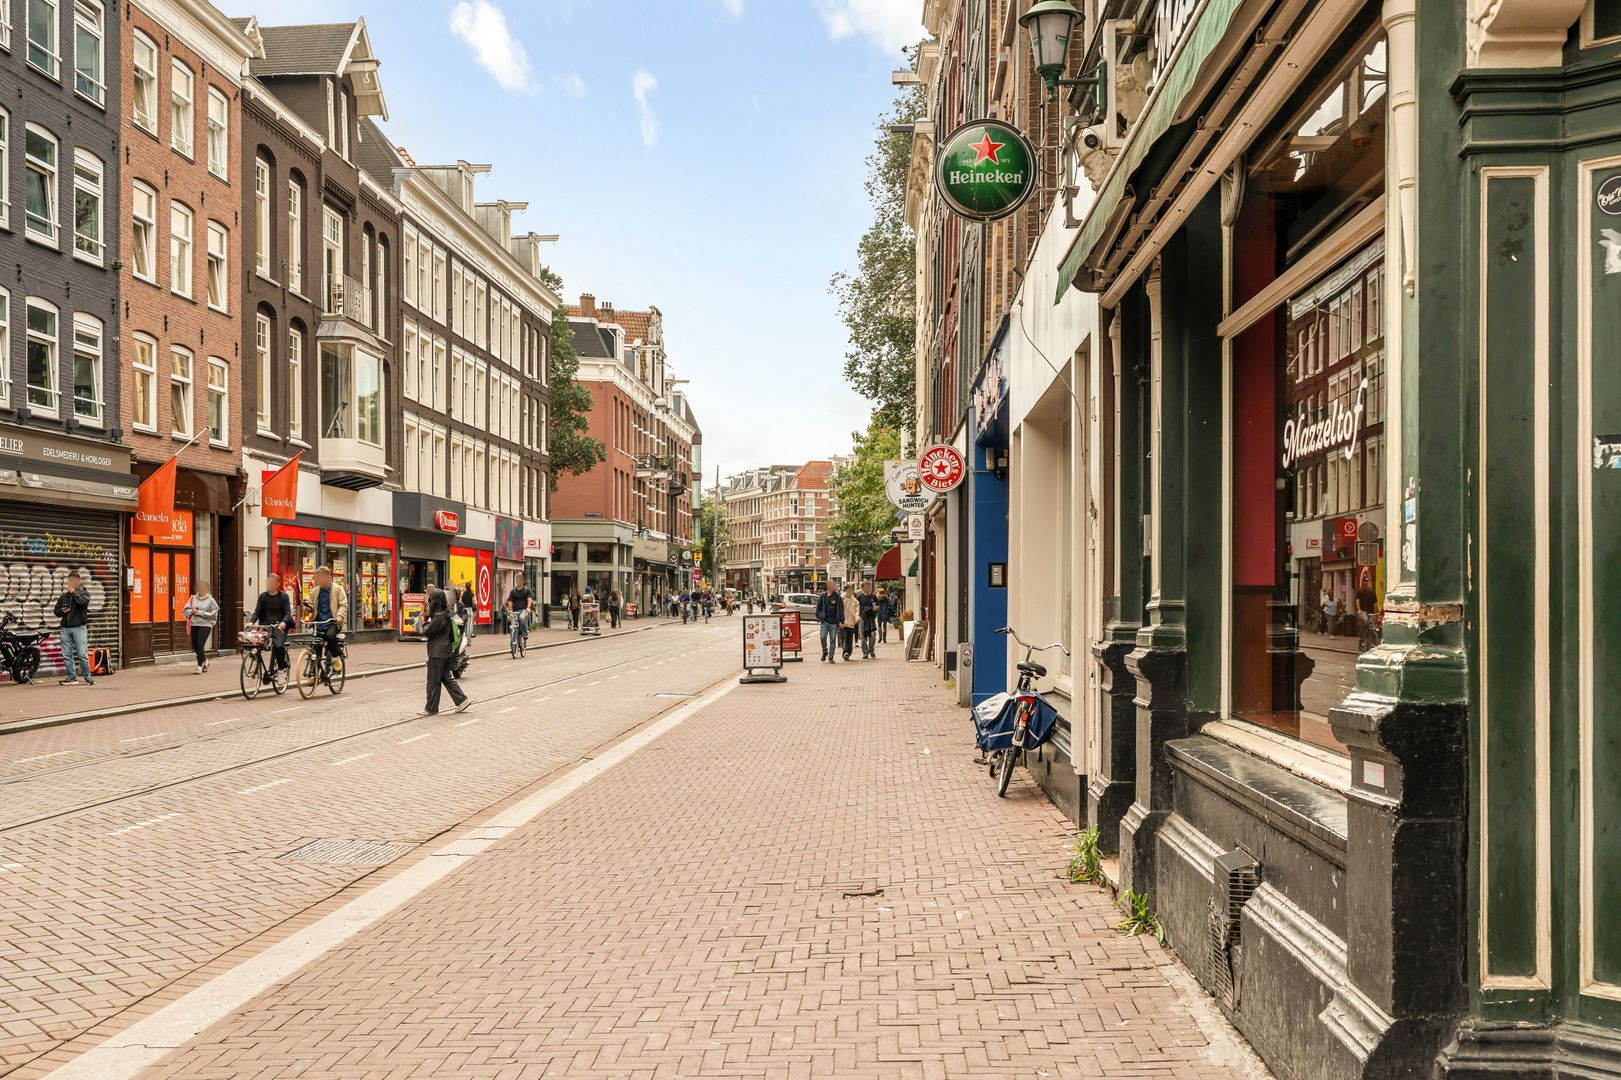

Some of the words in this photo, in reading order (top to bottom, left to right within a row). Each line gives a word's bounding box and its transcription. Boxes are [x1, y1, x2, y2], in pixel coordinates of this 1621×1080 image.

[949, 169, 1023, 185] Heineken
[1283, 377, 1368, 468] Mazzeltof
[0, 436, 24, 452] ELIER
[43, 447, 80, 461] EDELSMEDERIJ
[80, 454, 85, 462] &
[85, 455, 112, 467] HORLOGER
[921, 447, 961, 478] Heineken's
[931, 478, 953, 488] Bier
[264, 497, 293, 508] Canela
[898, 497, 929, 505] SANDWICH
[136, 511, 169, 523] Canela
